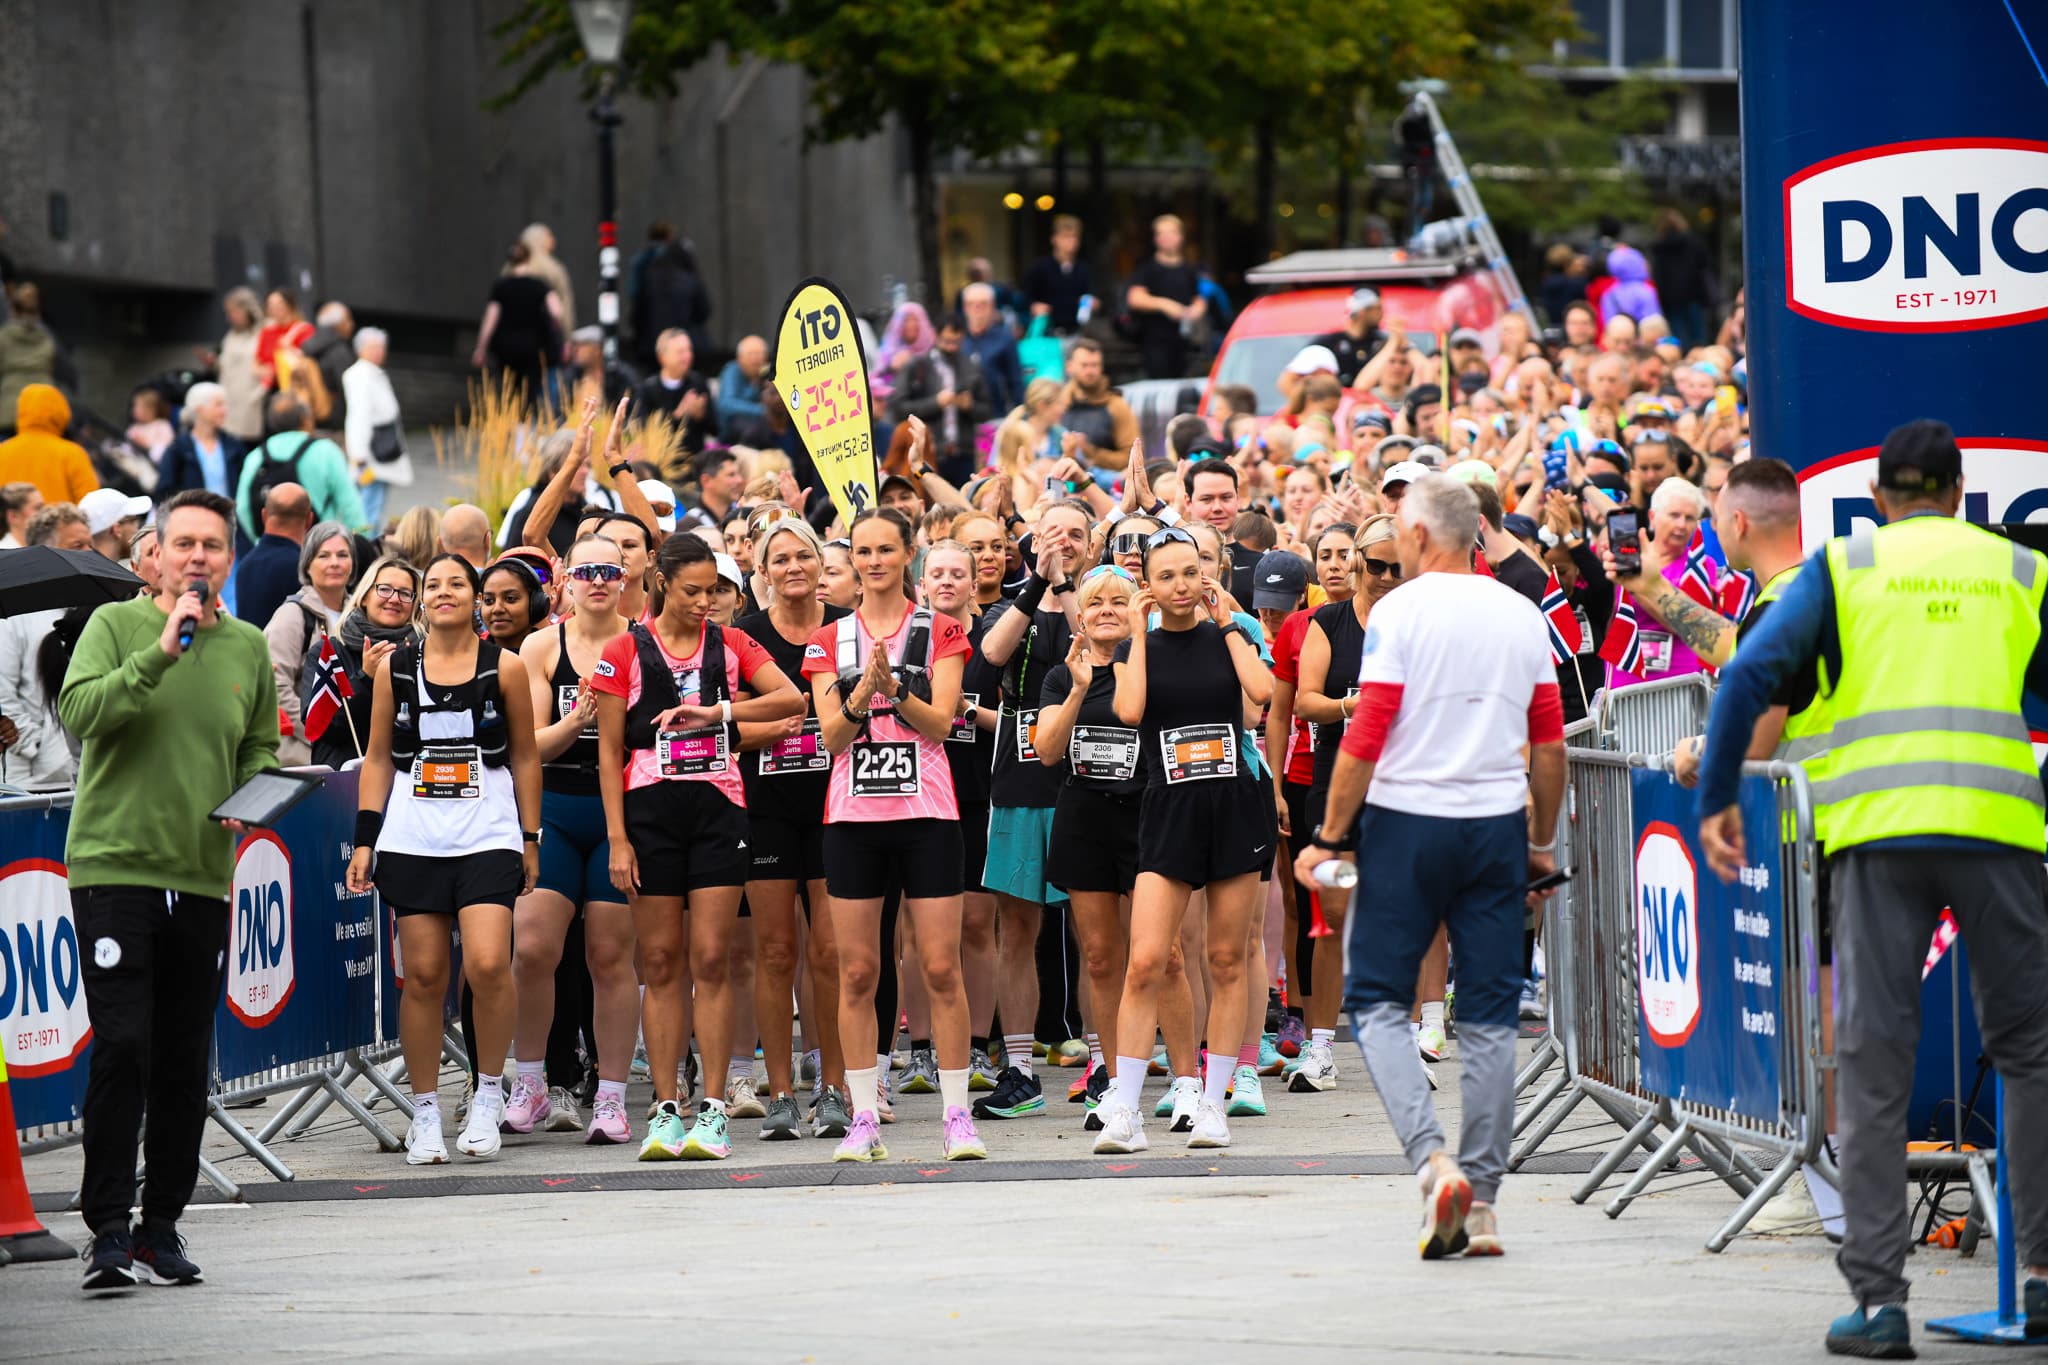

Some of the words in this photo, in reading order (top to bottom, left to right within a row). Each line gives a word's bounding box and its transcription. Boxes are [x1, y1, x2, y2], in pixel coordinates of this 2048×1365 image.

[1822, 187, 2048, 283] DNO
[1896, 292, 1933, 309] EST
[1953, 289, 1997, 306] 1971
[685, 740, 702, 749] 3331
[1091, 752, 1114, 760] Wendel
[856, 747, 913, 779] 2:25
[238, 880, 285, 976] DNO
[1642, 883, 1689, 985] DNO
[18, 1032, 33, 1050] EST
[38, 1028, 60, 1047] 1971
